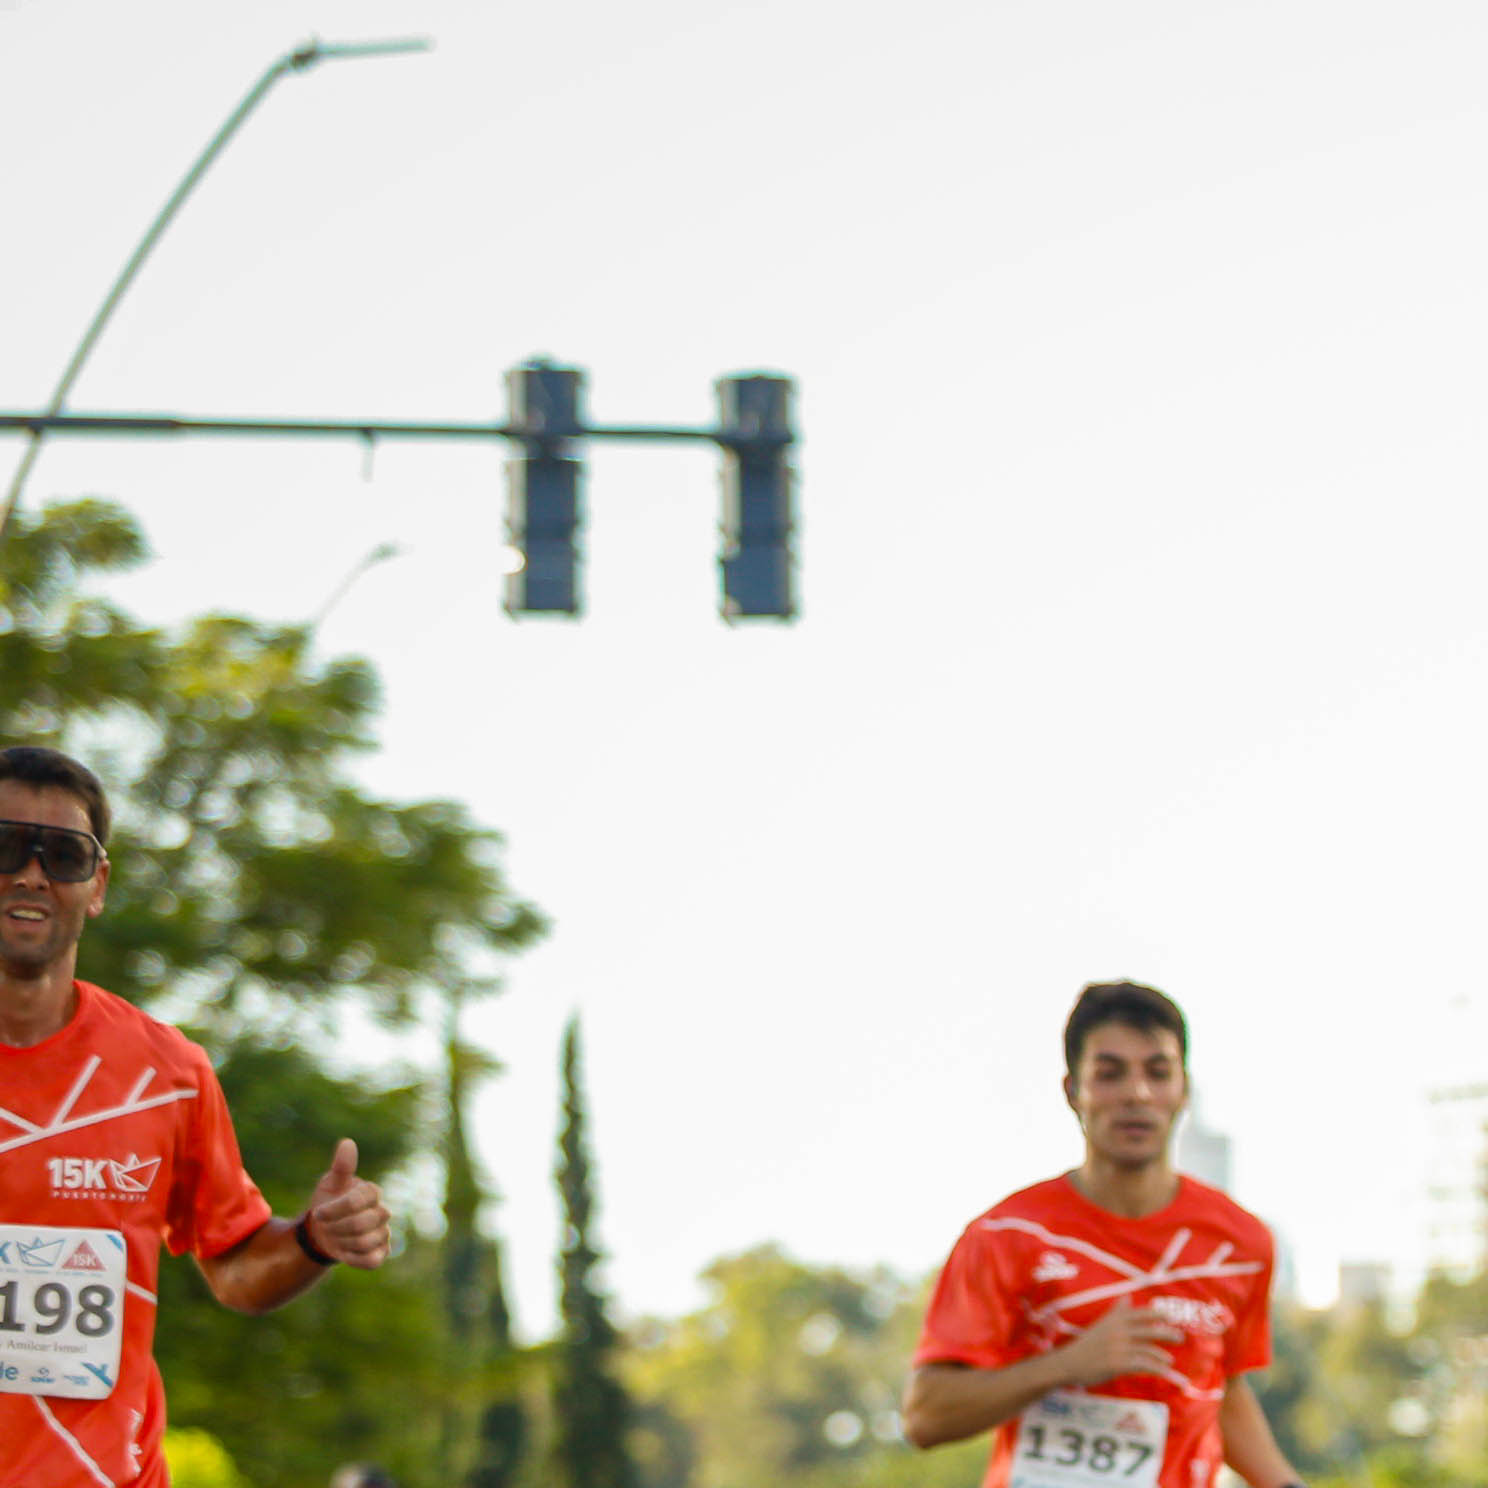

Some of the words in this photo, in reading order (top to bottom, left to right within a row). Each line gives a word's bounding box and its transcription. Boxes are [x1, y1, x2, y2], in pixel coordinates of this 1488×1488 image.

[48, 1157, 107, 1189] 15K
[72, 1254, 97, 1267] 15K
[0, 1280, 115, 1337] 198
[1022, 1425, 1154, 1478] 1387
